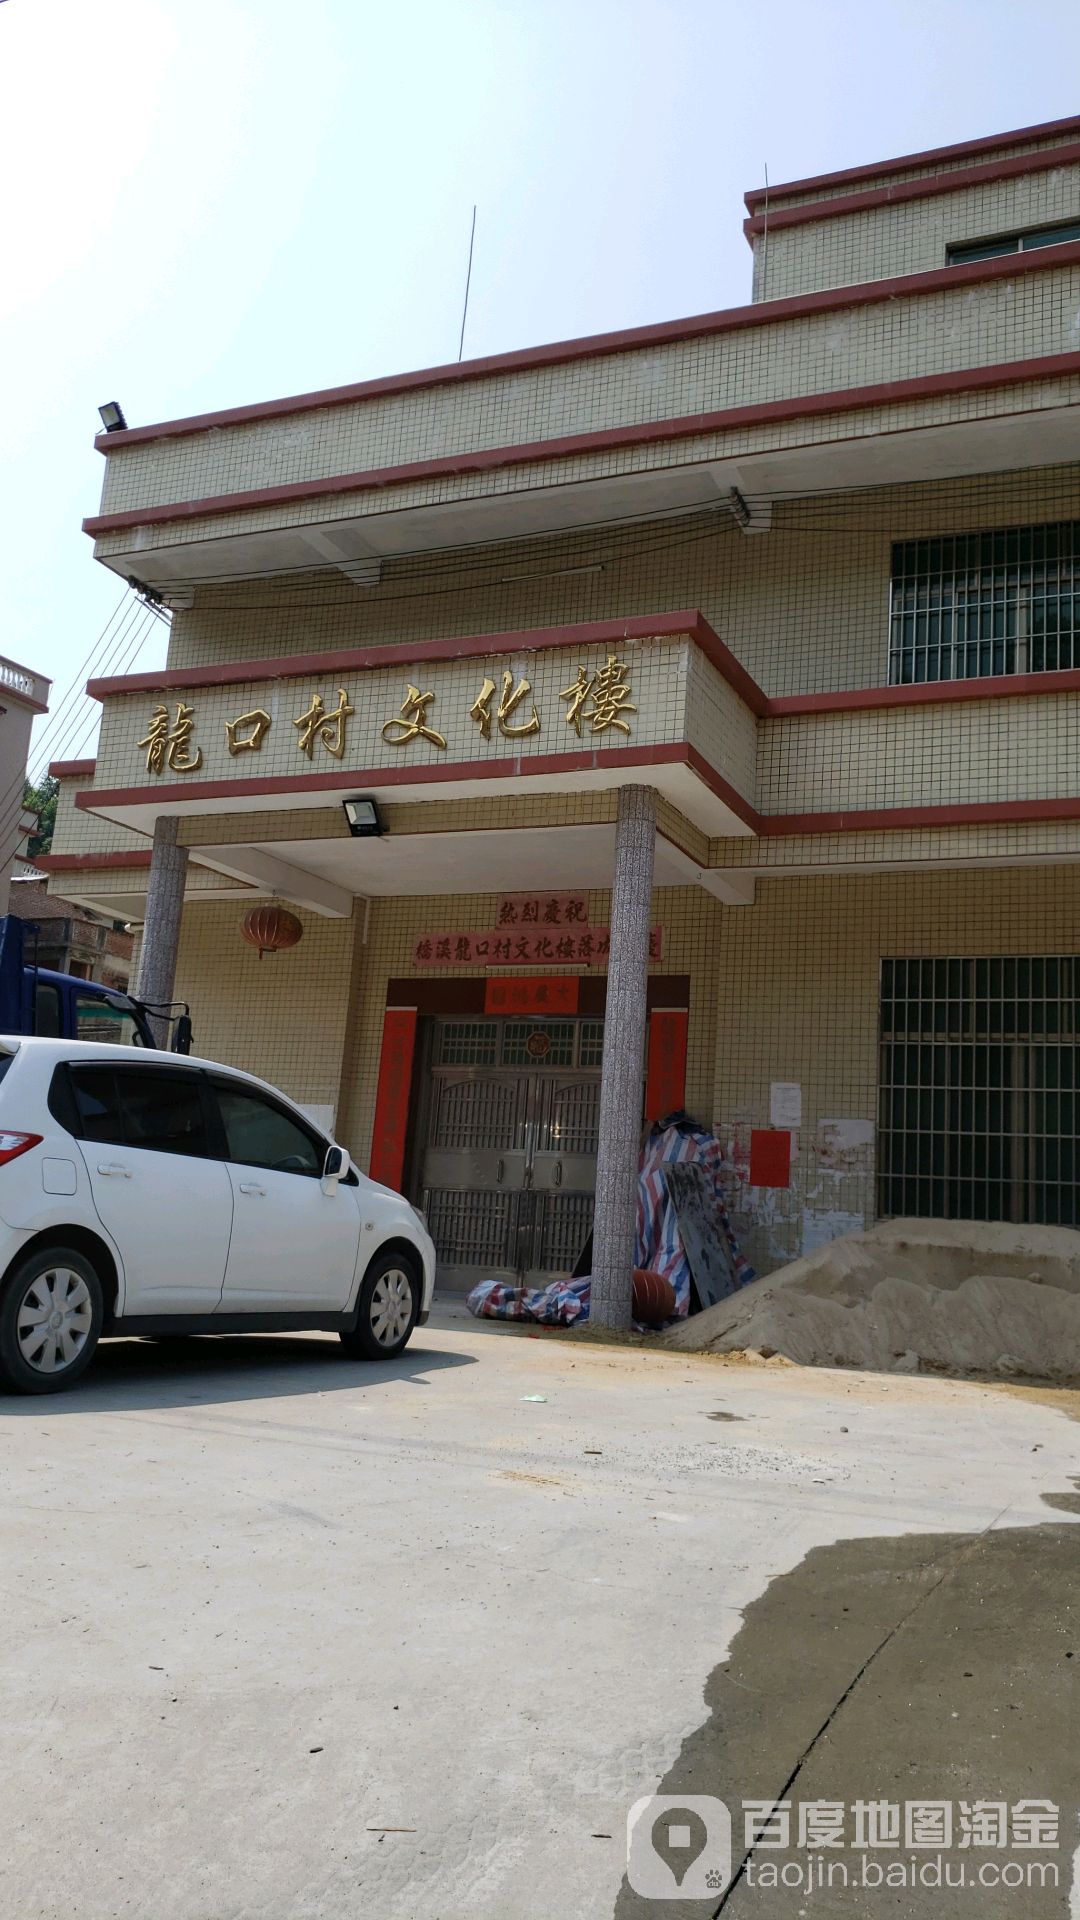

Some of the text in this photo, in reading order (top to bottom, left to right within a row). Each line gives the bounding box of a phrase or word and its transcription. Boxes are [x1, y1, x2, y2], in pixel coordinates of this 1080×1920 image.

[138, 656, 637, 774] 龍口村文化樓
[499, 899, 588, 924] 熱烈慶祝
